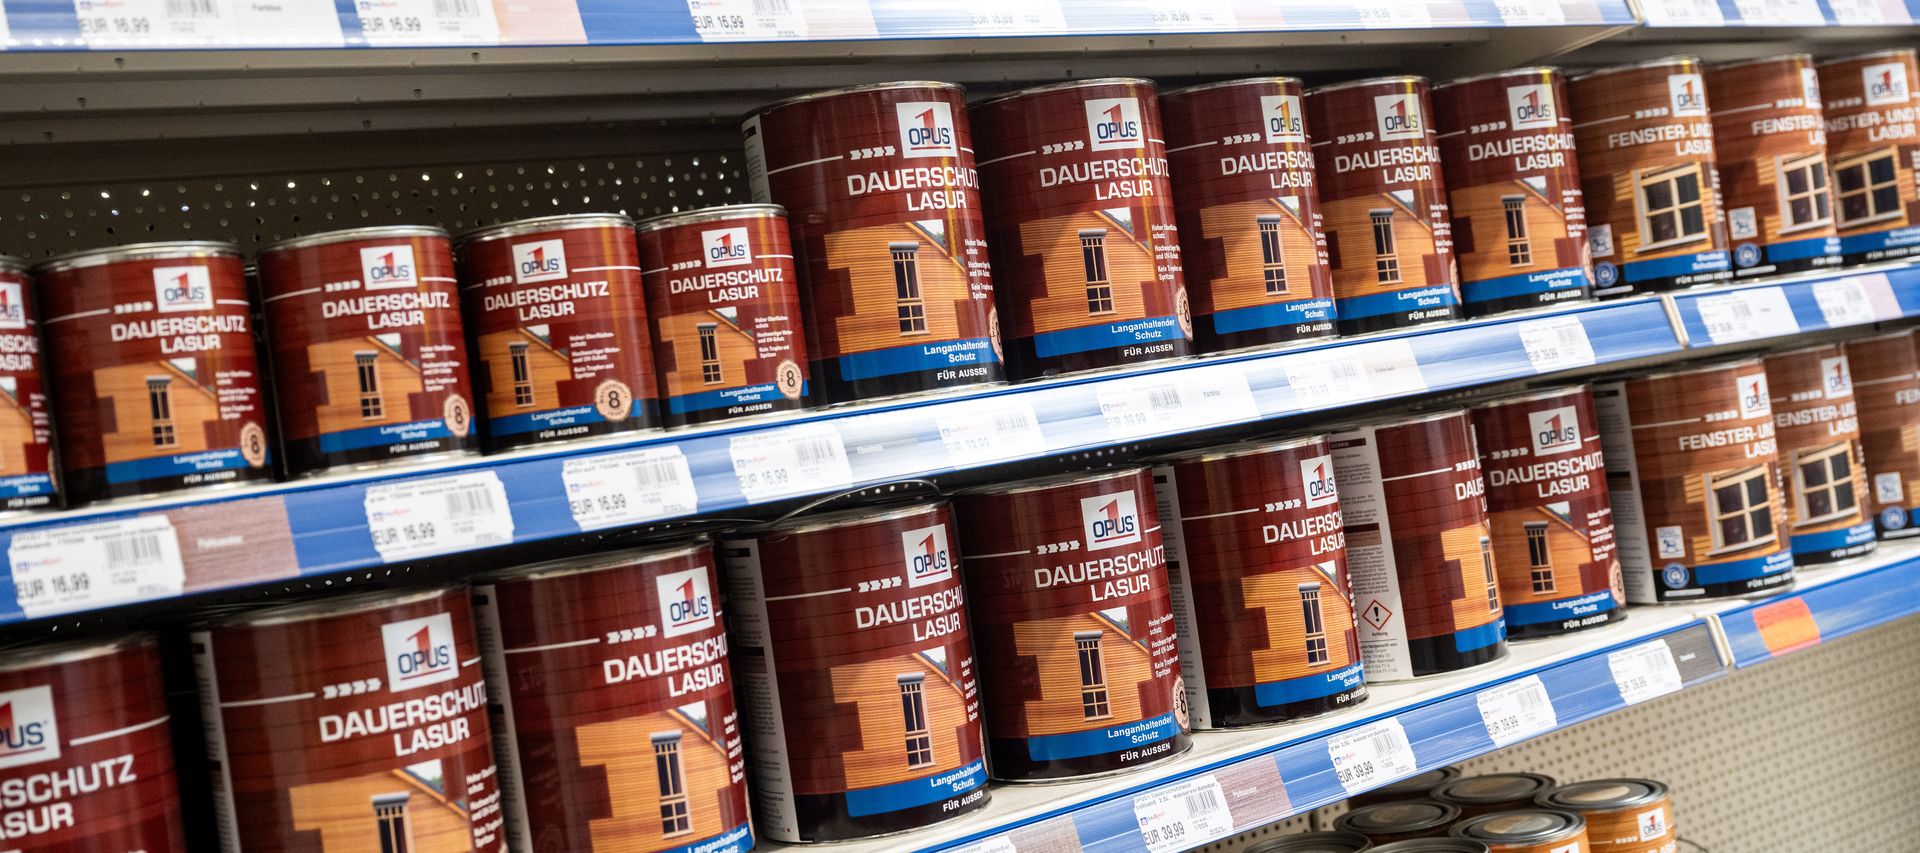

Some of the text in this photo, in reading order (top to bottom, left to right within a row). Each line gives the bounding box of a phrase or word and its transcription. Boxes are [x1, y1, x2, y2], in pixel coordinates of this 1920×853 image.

[694, 15, 715, 29] EUR
[1517, 105, 1551, 121] OPUS
[1097, 121, 1137, 140] OPUS
[1270, 117, 1300, 132] OPUS
[1385, 115, 1418, 130] OPUS
[909, 128, 950, 146] OPUS
[1868, 124, 1916, 142] LASUR
[1675, 140, 1712, 156] LASUR
[1221, 152, 1315, 176] DAUERSCHU
[1515, 153, 1564, 171] LASUR
[1040, 157, 1170, 188] DAUERSCHUTZ
[1270, 171, 1313, 189] LASUR
[1383, 165, 1432, 184] LASUR
[1095, 181, 1154, 201] LASUR
[907, 191, 966, 212] LASUR
[711, 245, 744, 260] OPUS
[371, 265, 409, 280] OPUS
[522, 258, 559, 275] OPUS
[670, 268, 783, 294] DAUERSCHUTZ
[1549, 278, 1572, 287] Schutz
[164, 287, 205, 302] OPUS
[484, 281, 610, 312] DAUERSCHUTZ
[708, 286, 758, 304] LASUR
[1418, 297, 1440, 306] Schutz
[1539, 293, 1555, 301] FÜR
[322, 292, 450, 318] DAUERSCHUTZ
[519, 301, 575, 322] LASUR
[1305, 310, 1325, 318] Schutz
[368, 311, 425, 330] LASUR
[1409, 312, 1424, 320] FÜR
[111, 315, 246, 342] DAUERSCHUTZ
[1112, 318, 1175, 334] Langanhaltender
[1135, 329, 1162, 340] Schutz
[1296, 325, 1311, 333] FÜR
[161, 335, 221, 354] LASUR
[924, 340, 988, 357] Langanhaltender
[1124, 344, 1174, 357] FÜR AUSSEN
[948, 352, 976, 364] Schutz
[787, 370, 795, 387] 8
[937, 367, 987, 380] FÜR AUSSEN
[608, 390, 620, 409] 8
[720, 384, 774, 398] Langanhaltender
[738, 393, 760, 402] Schutz
[531, 406, 592, 422] Langanhaltender
[729, 403, 772, 414] FÜR AUSSEN
[550, 416, 575, 426] Schutz
[402, 430, 427, 440] Schutz
[540, 426, 589, 439] FÜR AUSSEN
[1540, 427, 1575, 446] OPUS
[1490, 451, 1604, 488] DAUERSCHUTZ
[1310, 477, 1334, 497] OPUS
[1537, 475, 1590, 498] LASUR
[571, 499, 594, 515] EUR
[372, 528, 399, 545] EUR
[1093, 516, 1134, 539] OPUS
[914, 551, 947, 573] OPUS
[1034, 545, 1166, 589] DAUERSCHUTZ
[16, 579, 45, 600] EUR
[1091, 575, 1150, 602] LASUR
[670, 596, 708, 622] OPUS
[856, 584, 963, 629] DAUERSCHU
[1552, 592, 1609, 610] Langanhaltender
[1573, 603, 1597, 614] Schutz
[913, 614, 961, 642] LASUR
[1563, 614, 1608, 630] FÜR AUSSEN
[398, 646, 449, 674] OPUS
[603, 632, 728, 684] DAUERSCHU
[668, 663, 724, 697] LASUR
[1336, 693, 1350, 704] FÜR
[1107, 716, 1172, 739] Langanhaltender
[394, 718, 469, 757] LASUR
[1131, 732, 1159, 744] Schutz
[1120, 742, 1171, 762] FÜR AUSSEN
[0, 754, 136, 808] SCHUTZ
[931, 762, 982, 787] Langanhaltender
[1338, 761, 1374, 783] EUR 39,99
[952, 779, 975, 792] Schutz
[943, 800, 959, 812] FÜR
[0, 802, 74, 841] SUR
[1143, 821, 1185, 846] EUR 39,99
